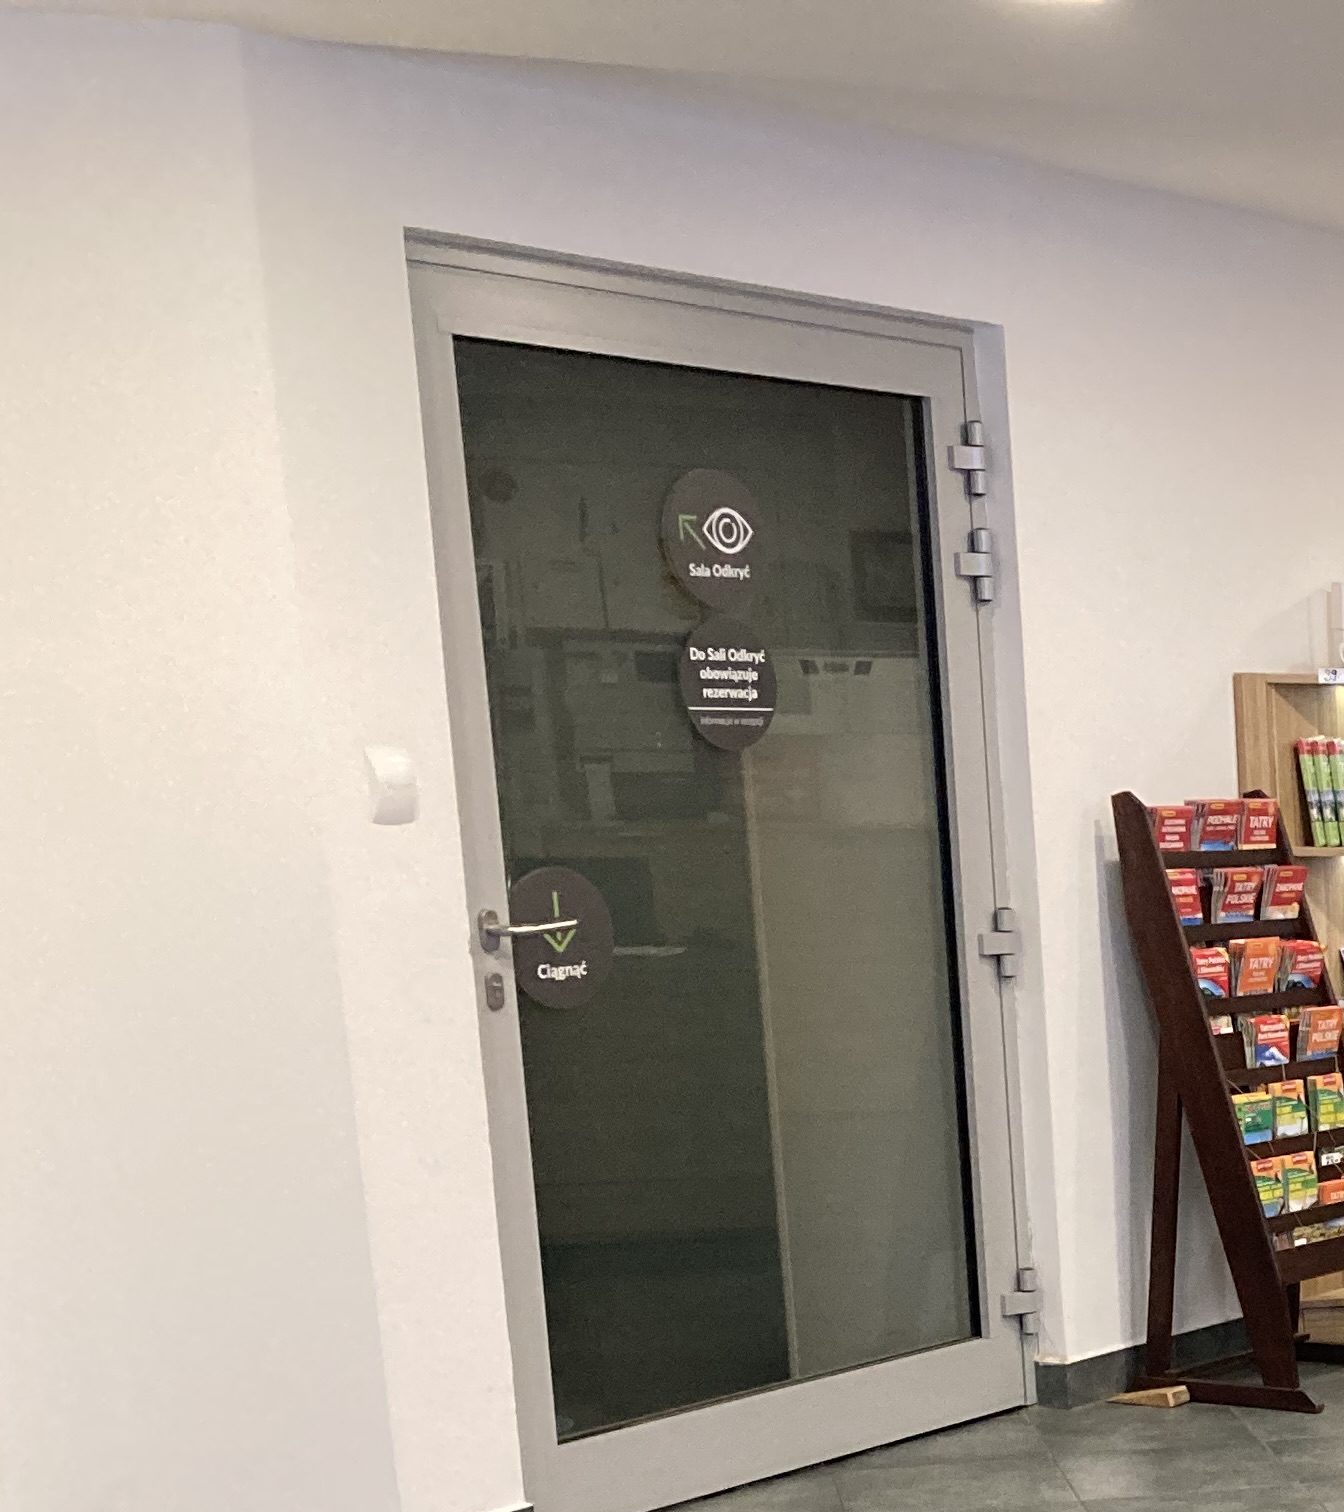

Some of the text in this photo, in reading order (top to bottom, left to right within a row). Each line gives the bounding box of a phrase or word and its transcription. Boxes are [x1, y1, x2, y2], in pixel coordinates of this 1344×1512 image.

[688, 563, 751, 581] Sala Odkryć
[689, 647, 766, 665] Do Sali Odkryć
[700, 666, 759, 684] obowiązuje
[702, 686, 759, 702] rezerwacja
[537, 960, 588, 981] Ciągnąć
